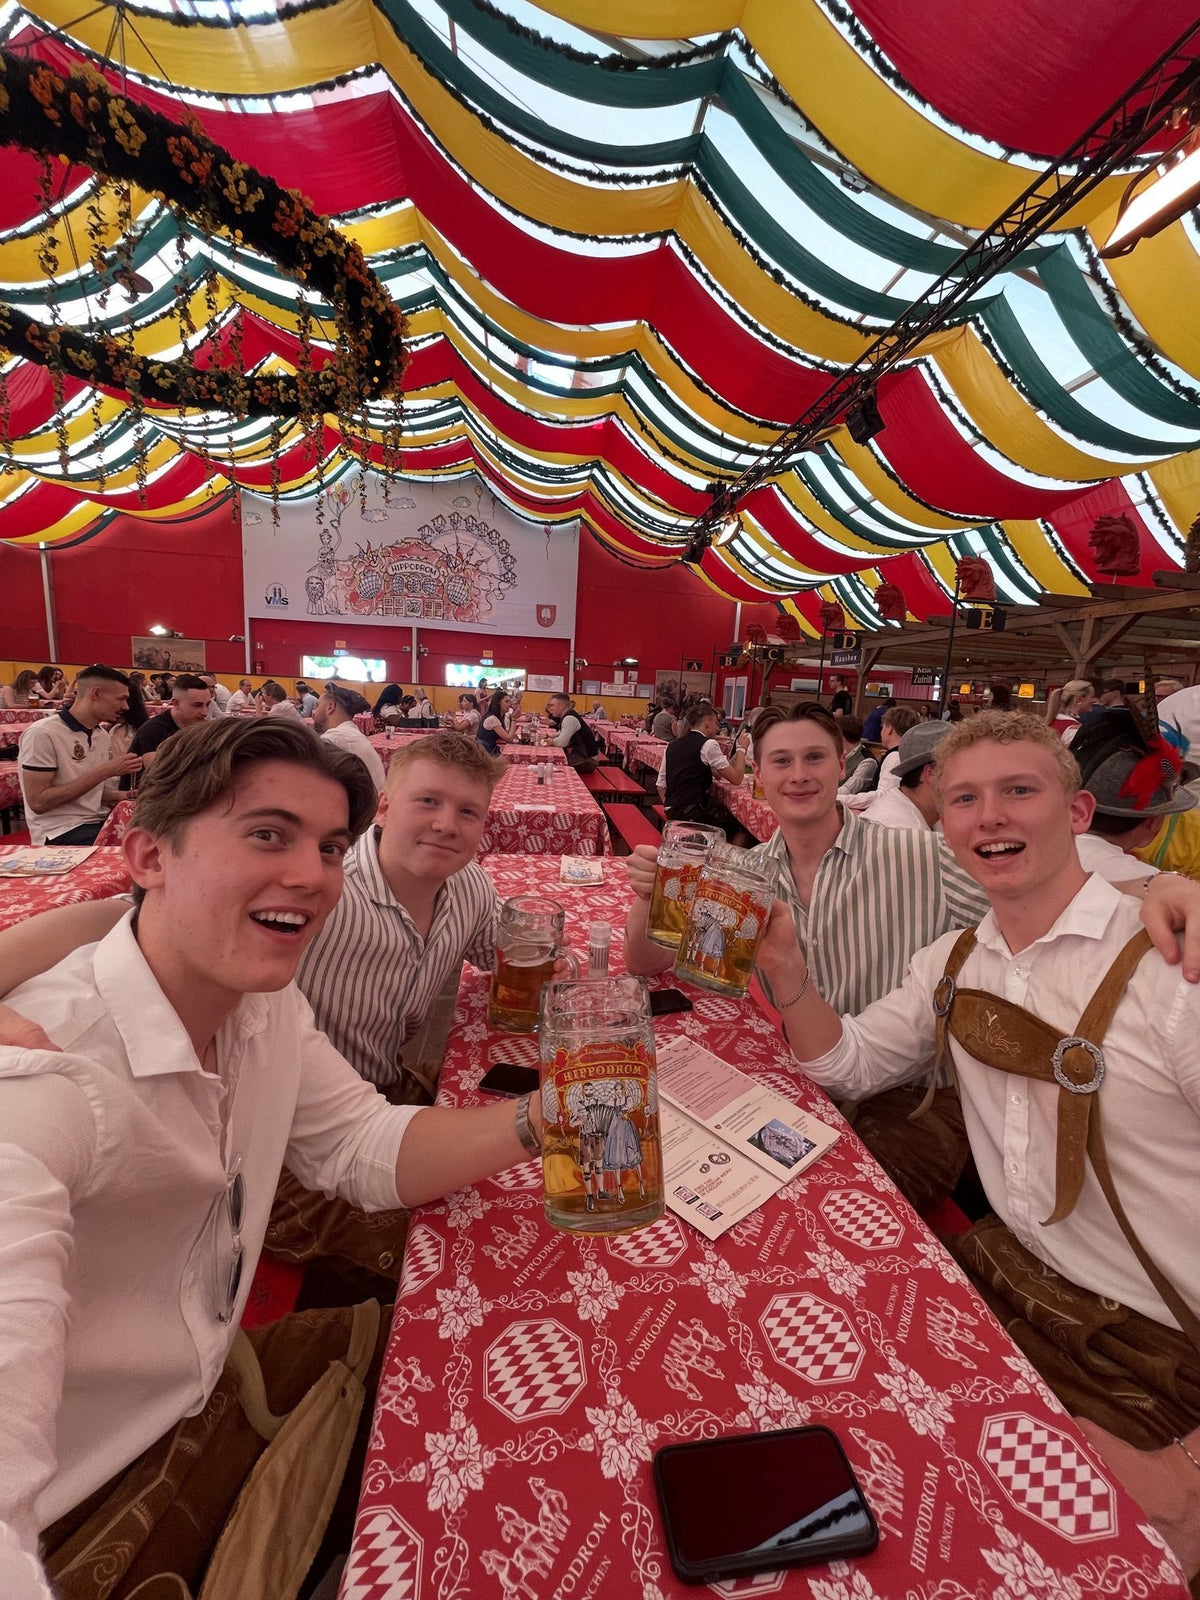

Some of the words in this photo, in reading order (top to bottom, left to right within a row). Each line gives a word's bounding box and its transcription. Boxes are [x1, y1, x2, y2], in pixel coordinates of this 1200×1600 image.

[391, 562, 437, 576] HIPPODROM
[264, 596, 289, 606] VMS
[979, 610, 995, 630] E
[842, 634, 857, 650] D
[725, 656, 732, 666] B
[768, 648, 779, 661] C
[690, 662, 699, 671] A
[563, 1064, 641, 1082] HIPPODROM
[757, 1211, 790, 1263] HIPPODROM
[512, 1231, 567, 1288] HIPPODROM
[895, 1278, 918, 1344] HIPPODROM
[626, 1298, 677, 1372] HIPPODROM
[910, 1461, 940, 1573] HIPPODROM
[939, 1501, 956, 1563] MÜNCHEN
